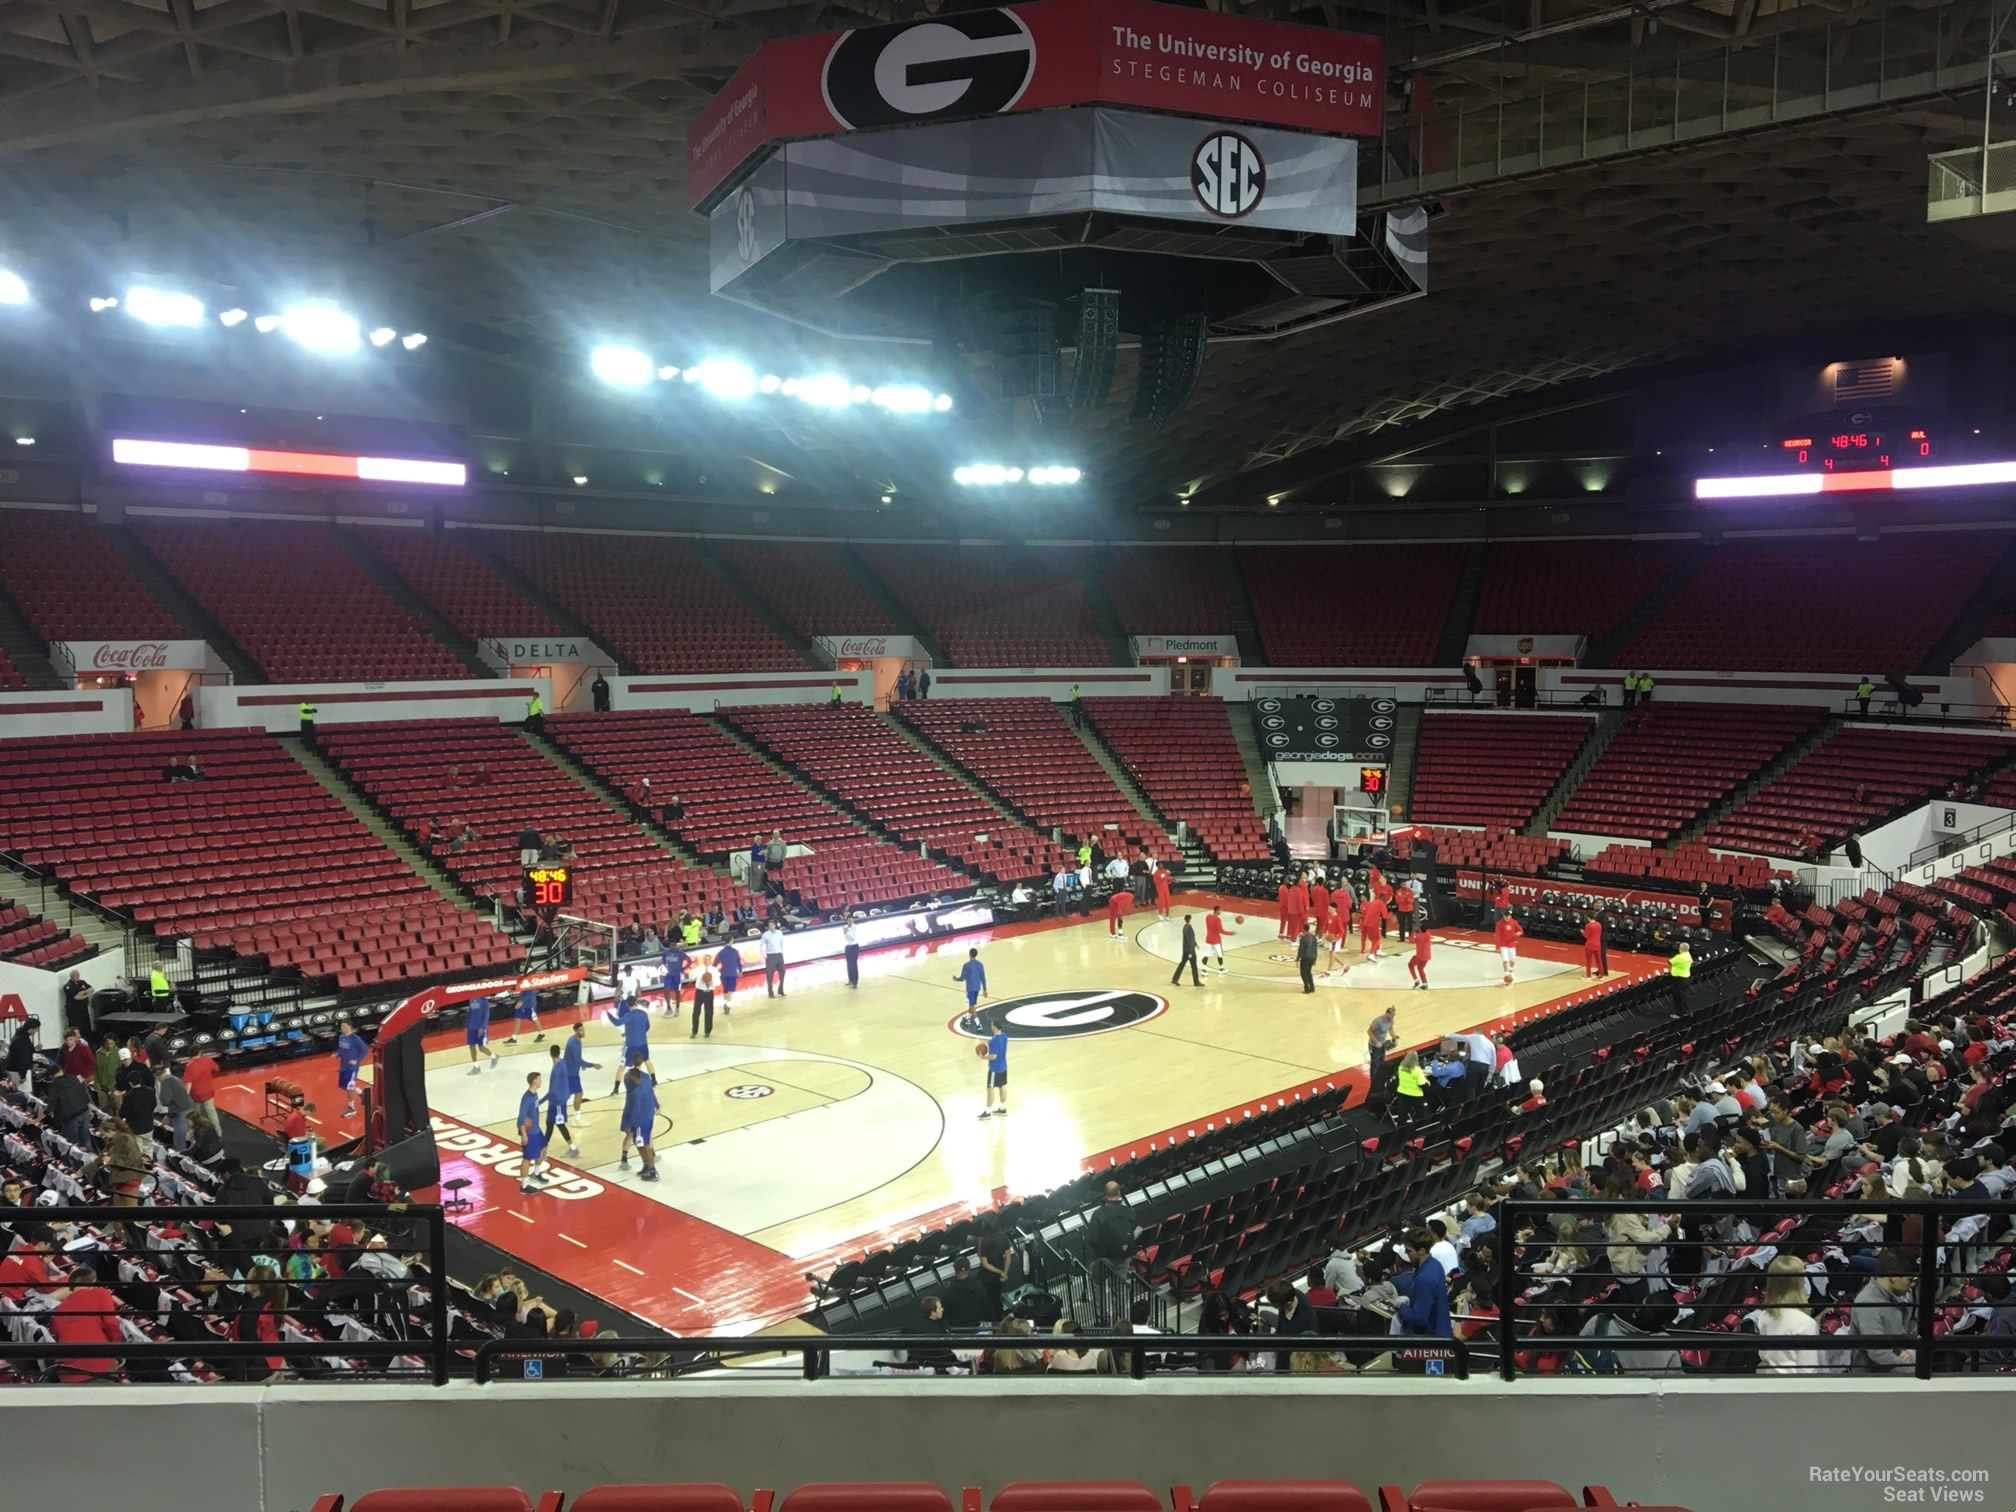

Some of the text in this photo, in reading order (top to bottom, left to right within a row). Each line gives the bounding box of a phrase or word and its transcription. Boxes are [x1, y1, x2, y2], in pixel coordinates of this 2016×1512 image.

[1112, 26, 1373, 84] The University of Georgia
[1113, 58, 1372, 109] STEGEMAN COLISEUM
[1196, 135, 1260, 214] SEC
[1832, 434, 1867, 448] 48:46
[1799, 443, 1929, 463] 0 0
[1824, 459, 1833, 469] 4
[1880, 456, 1889, 466] 4
[514, 644, 579, 657] DELTA
[841, 638, 887, 656] Coca-Cola
[1166, 640, 1218, 651] Piedmont
[1518, 641, 1533, 652] ups
[93, 643, 168, 668] Coca-Cola
[1275, 751, 1384, 761] georgiadogs.com
[1365, 778, 1379, 791] 30
[1946, 814, 1953, 826] 3
[529, 869, 566, 882] 48:46
[535, 882, 562, 903] 30
